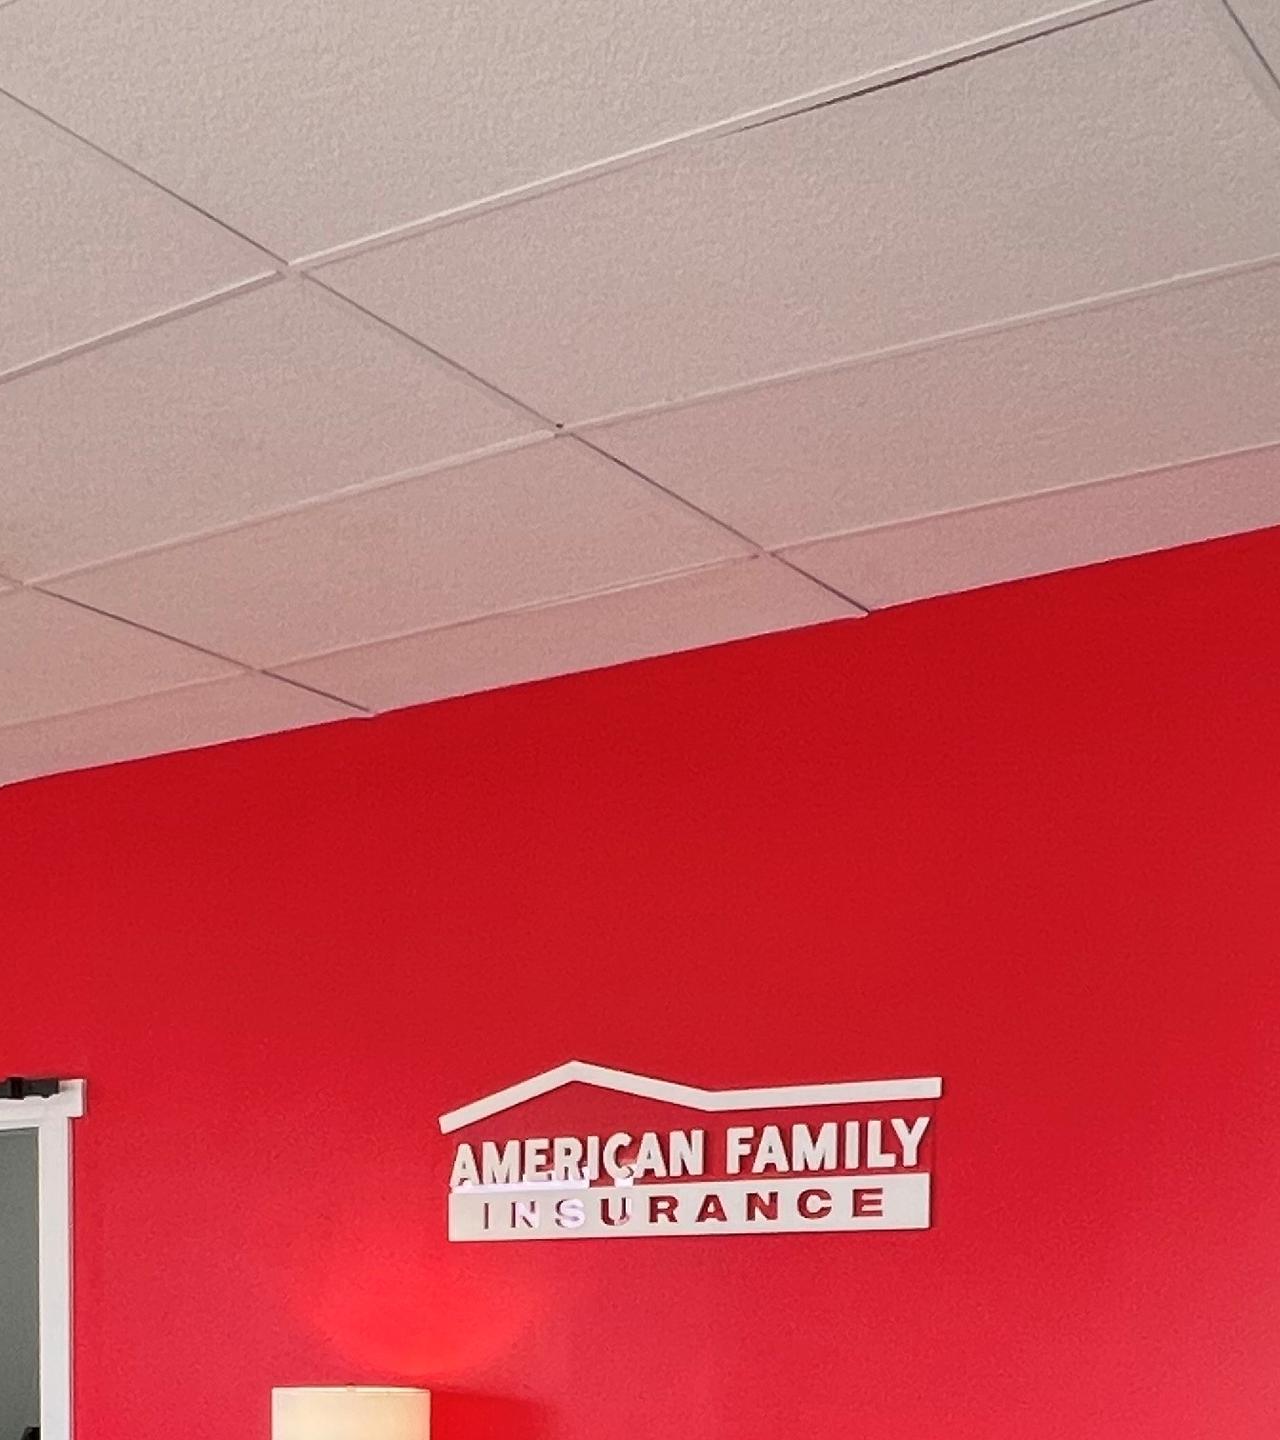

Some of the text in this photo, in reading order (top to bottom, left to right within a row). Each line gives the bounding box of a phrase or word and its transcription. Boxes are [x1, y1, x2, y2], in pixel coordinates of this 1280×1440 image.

[449, 1116, 931, 1189] AMERICAN FAMILY
[482, 1187, 885, 1231] INSURANCE
